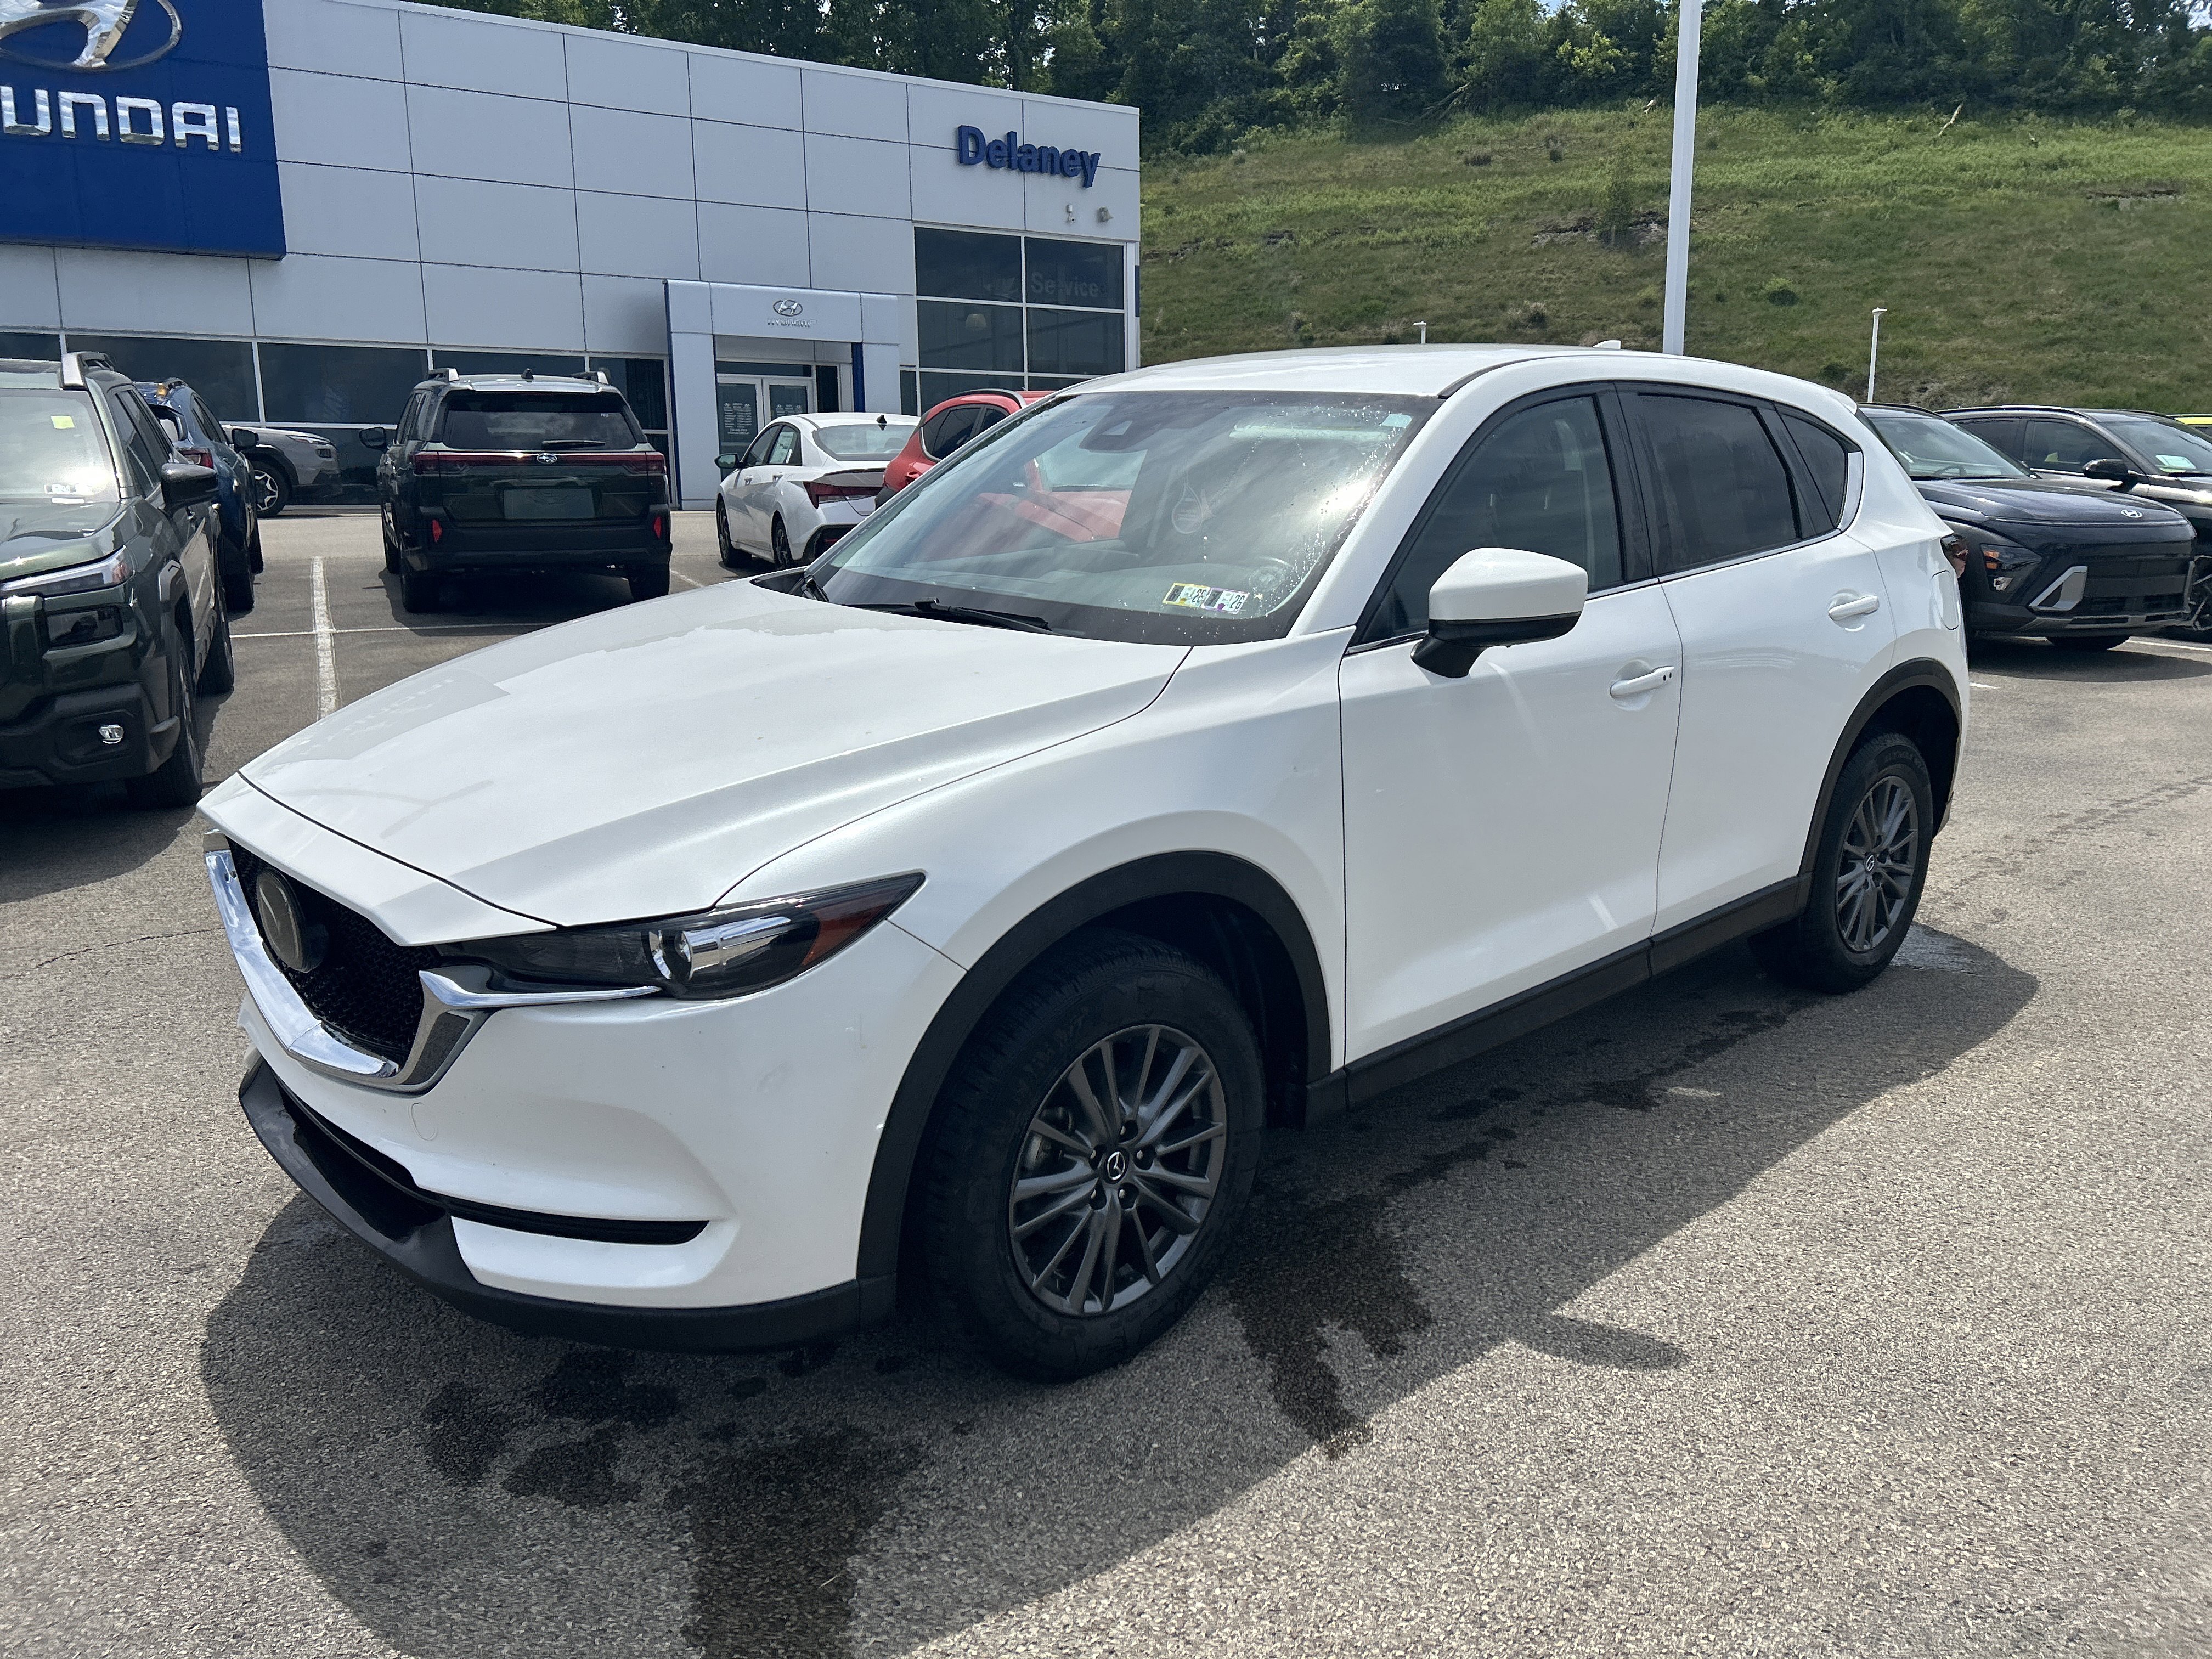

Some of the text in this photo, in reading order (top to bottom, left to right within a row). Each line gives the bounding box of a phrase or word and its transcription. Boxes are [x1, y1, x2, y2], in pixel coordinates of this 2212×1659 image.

[957, 125, 1101, 188] Delaney
[768, 318, 811, 328] HYUNDAI
[1230, 594, 1245, 609] 26
